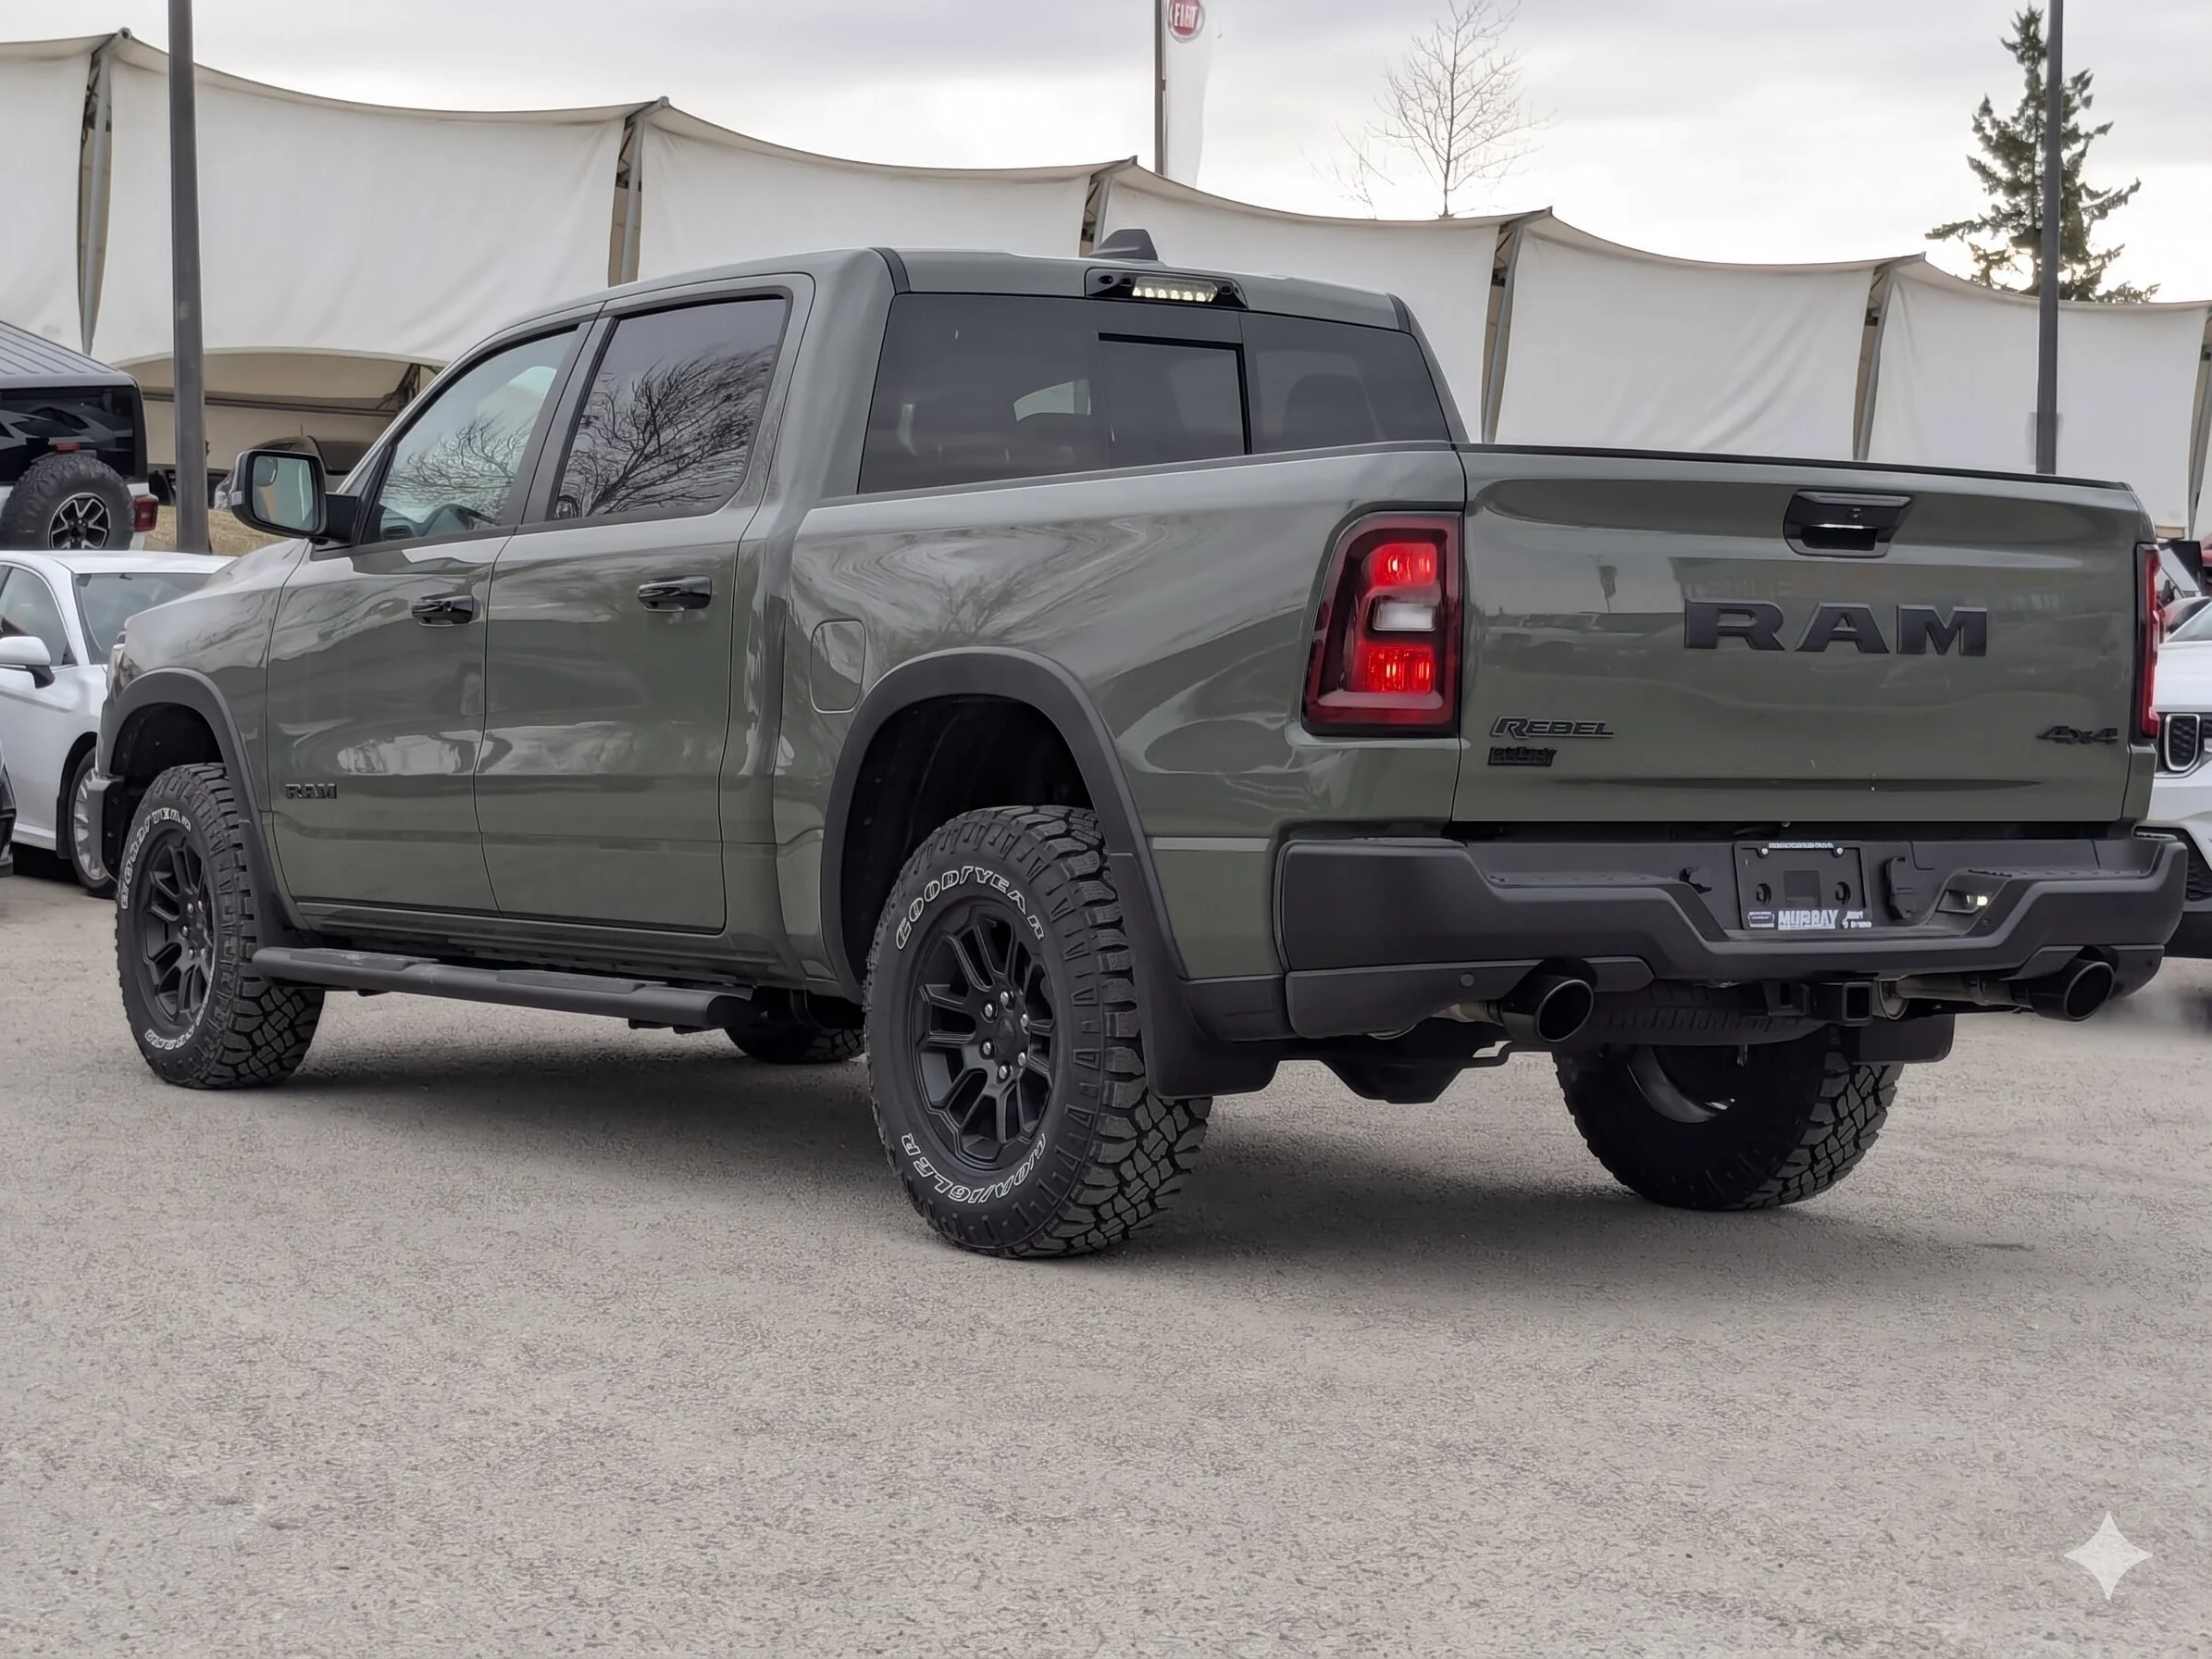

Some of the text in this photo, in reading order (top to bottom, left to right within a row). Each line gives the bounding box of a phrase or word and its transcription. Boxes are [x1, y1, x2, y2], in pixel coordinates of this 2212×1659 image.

[1174, 3, 1198, 29] FIAT
[1684, 598, 1988, 656] RAM
[1490, 716, 1614, 740] REBEL
[285, 783, 337, 800] RAM
